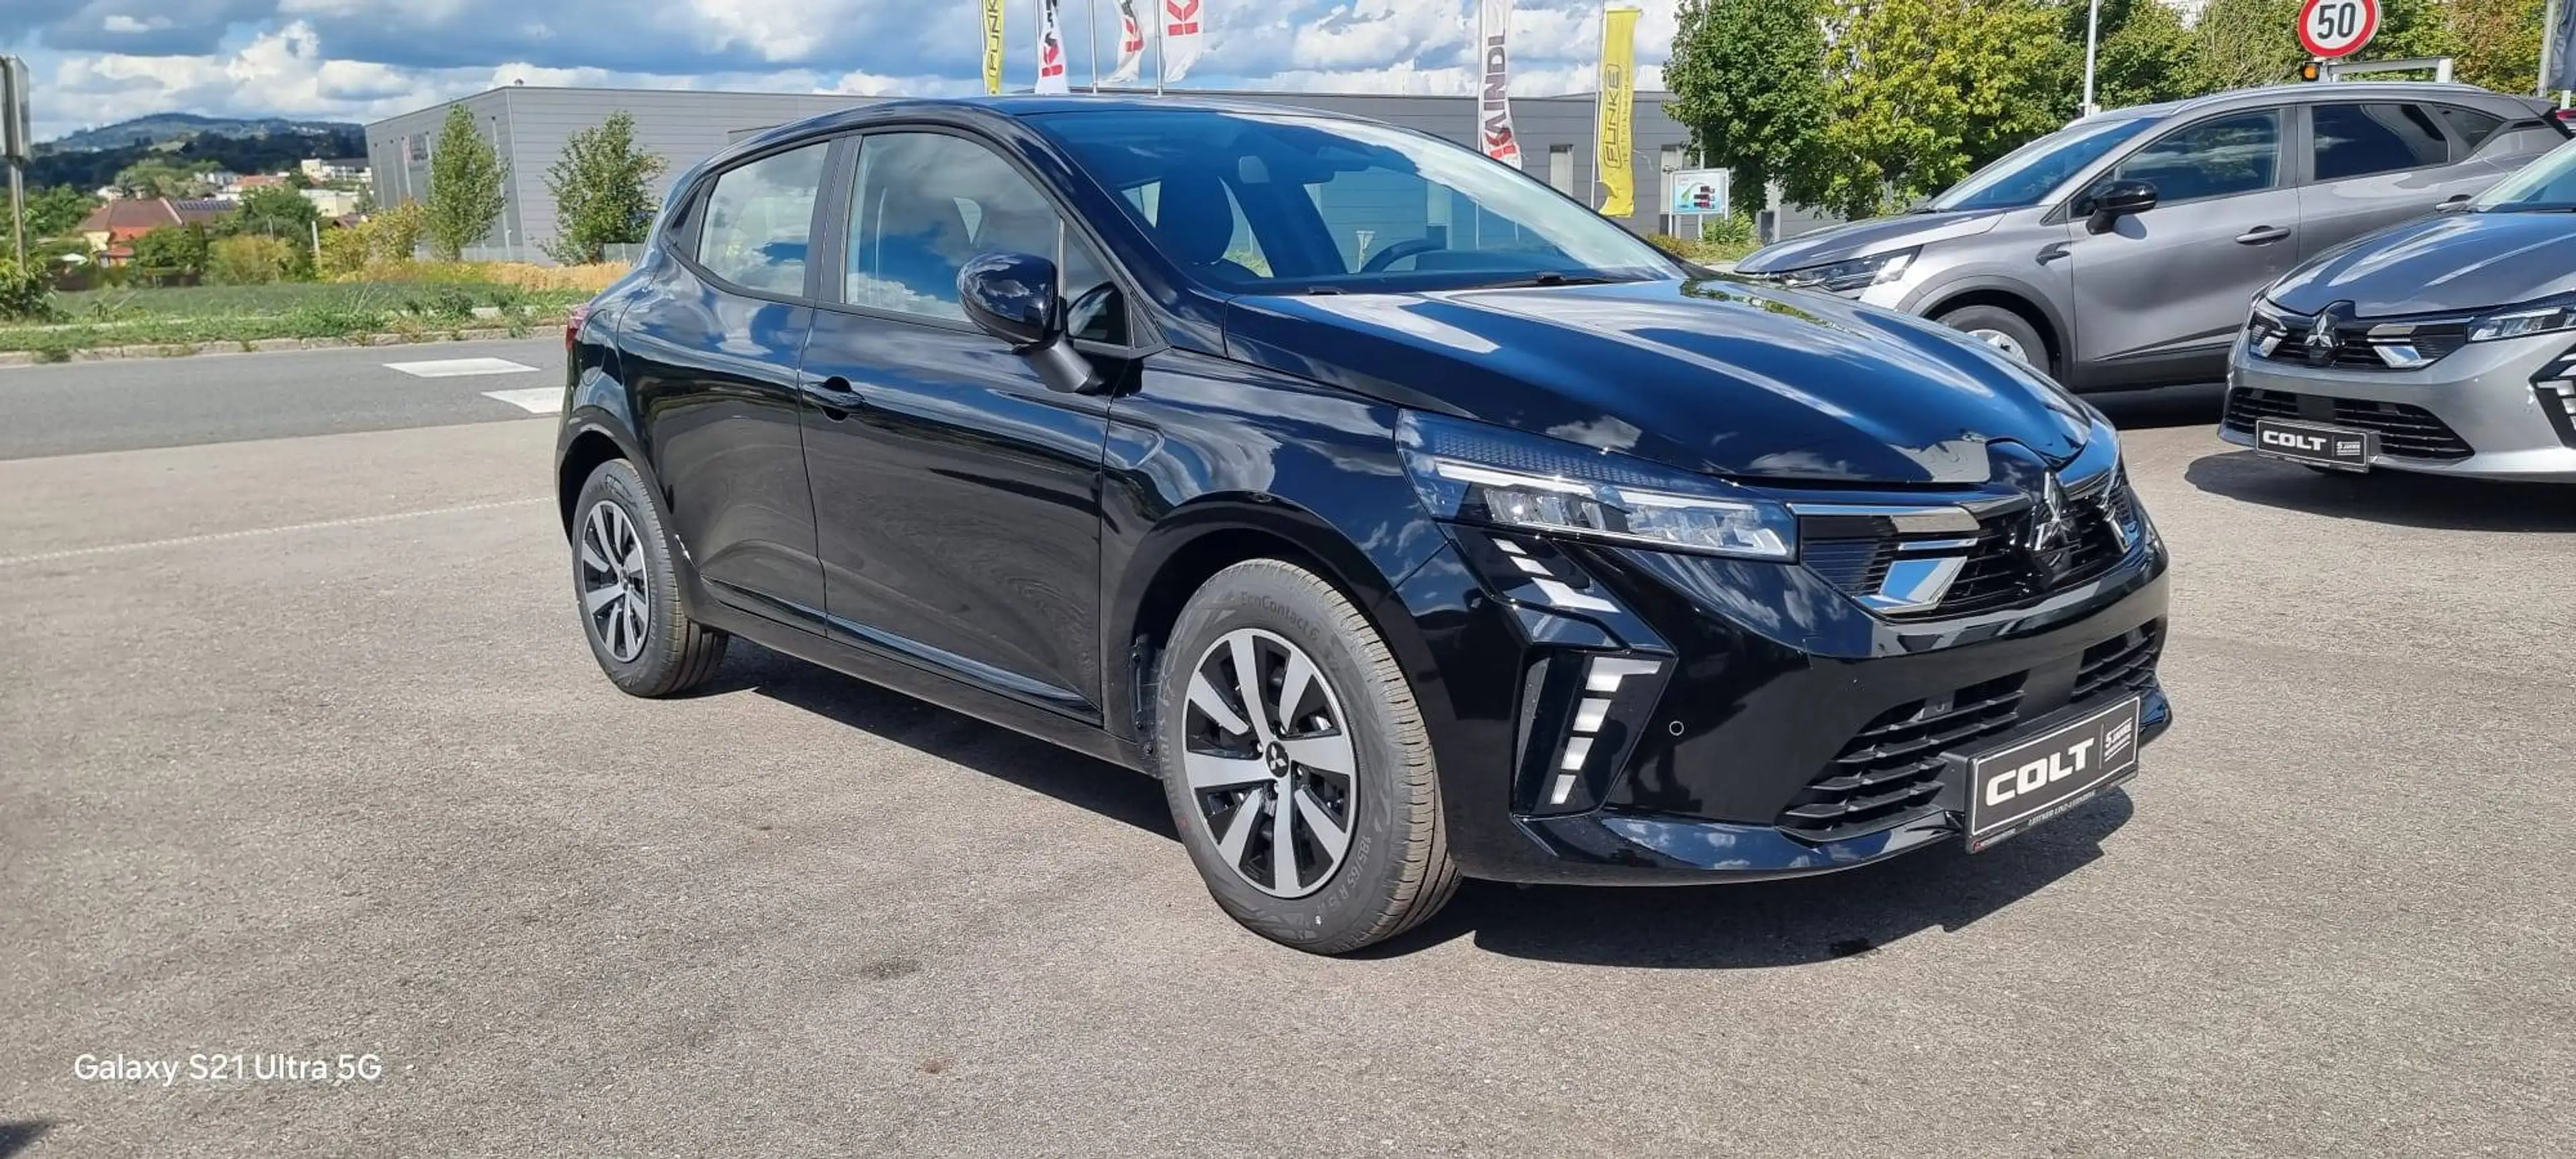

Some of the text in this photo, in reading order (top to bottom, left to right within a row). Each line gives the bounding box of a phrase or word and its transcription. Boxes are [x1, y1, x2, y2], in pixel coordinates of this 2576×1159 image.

[2316, 2, 2356, 40] 50
[1483, 29, 1517, 160] KAINDL
[1603, 69, 1620, 164] FUNKE
[2262, 430, 2327, 451] COLT
[1986, 738, 2094, 807] COLT
